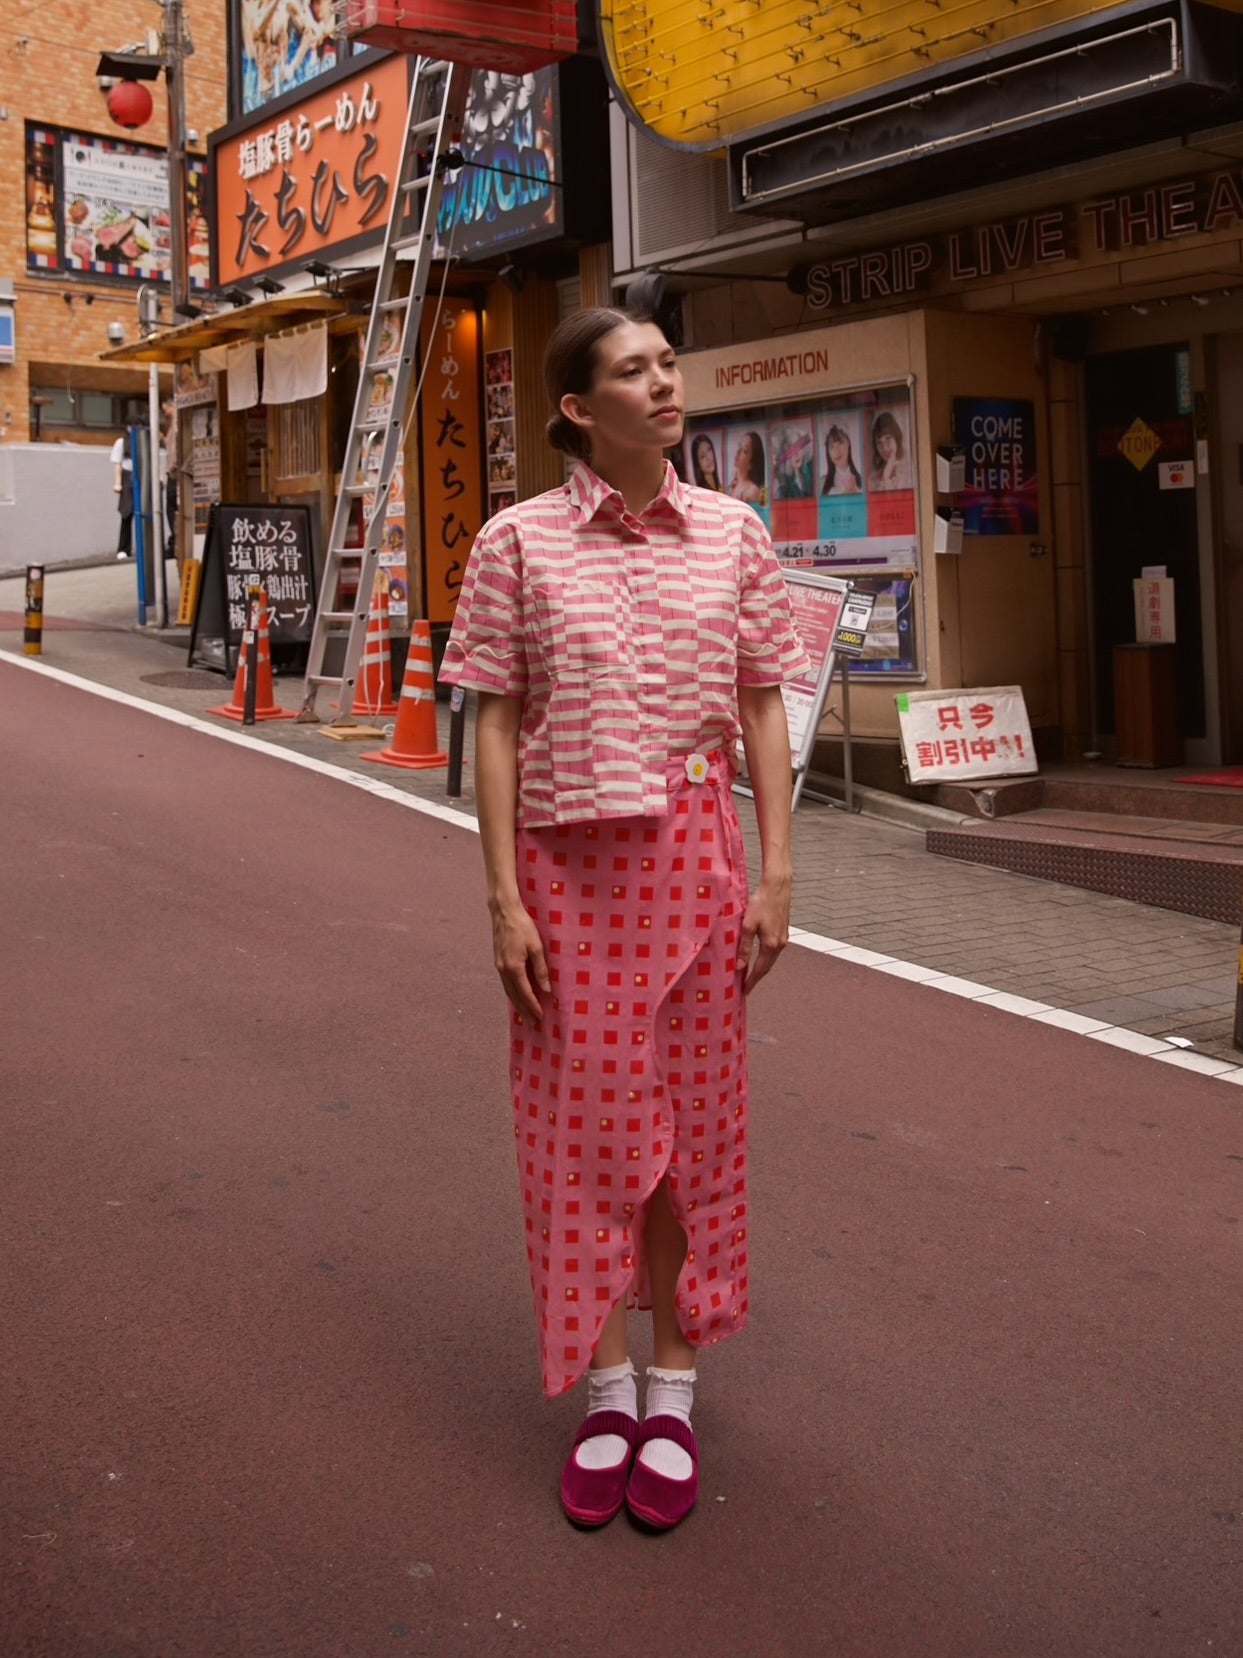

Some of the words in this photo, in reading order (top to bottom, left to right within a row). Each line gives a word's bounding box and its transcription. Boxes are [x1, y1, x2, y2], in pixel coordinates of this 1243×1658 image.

[239, 82, 379, 180] 塩豚骨らーめん
[235, 132, 389, 267] たちひら
[807, 241, 932, 310] STRIP
[949, 212, 1065, 282] LIVE
[440, 309, 460, 400] らーめん
[716, 349, 829, 389] INFORMATION
[971, 416, 1023, 438] COME
[972, 442, 1023, 464] OVER
[973, 468, 1023, 490] HERE
[1168, 464, 1184, 472] VISA
[232, 518, 297, 543] 飲める
[229, 545, 302, 571] 塩豚骨
[783, 546, 804, 558] 4.21
[813, 545, 837, 557] 4.30
[229, 603, 311, 629] 極スープ
[938, 703, 994, 731] 只今
